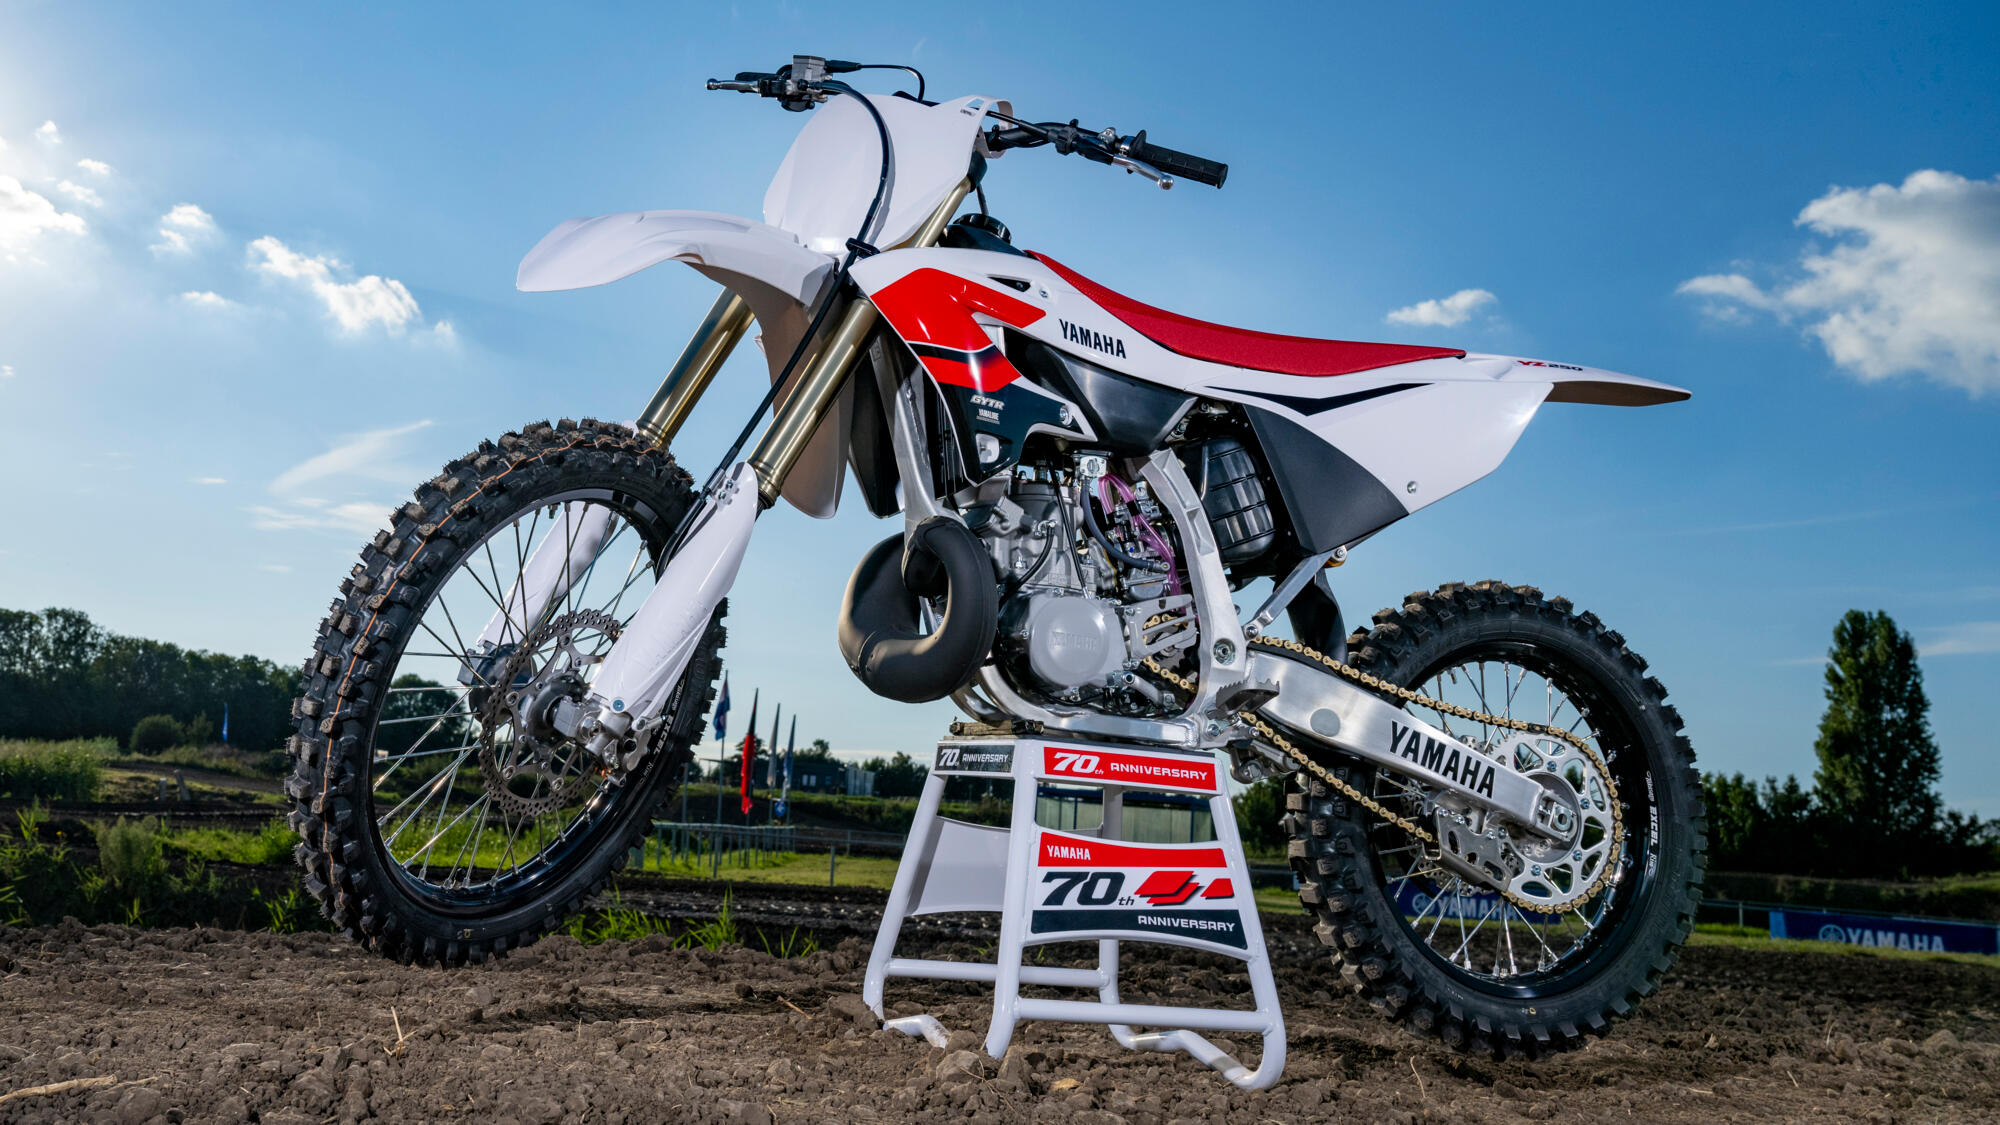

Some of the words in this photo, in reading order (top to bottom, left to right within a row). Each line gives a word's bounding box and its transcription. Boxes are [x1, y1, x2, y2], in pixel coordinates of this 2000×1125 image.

[1058, 318, 1127, 359] YAMAHA
[970, 394, 1005, 411] GYTR
[654, 715, 674, 755] EXCEL
[962, 753, 1009, 763] ANNIVERSARY
[1053, 752, 1104, 775] 70th
[1110, 762, 1208, 781] ANNIVERSARY
[1390, 720, 1496, 799] YAMAHA
[1649, 805, 1659, 847] EXCEL
[1047, 845, 1091, 861] YAMAHA
[1041, 871, 1135, 906] 70th
[1437, 898, 1518, 921] YAMAHA
[1137, 915, 1236, 932] ANNIVERSARY
[1846, 927, 1945, 953] YAMAHA
